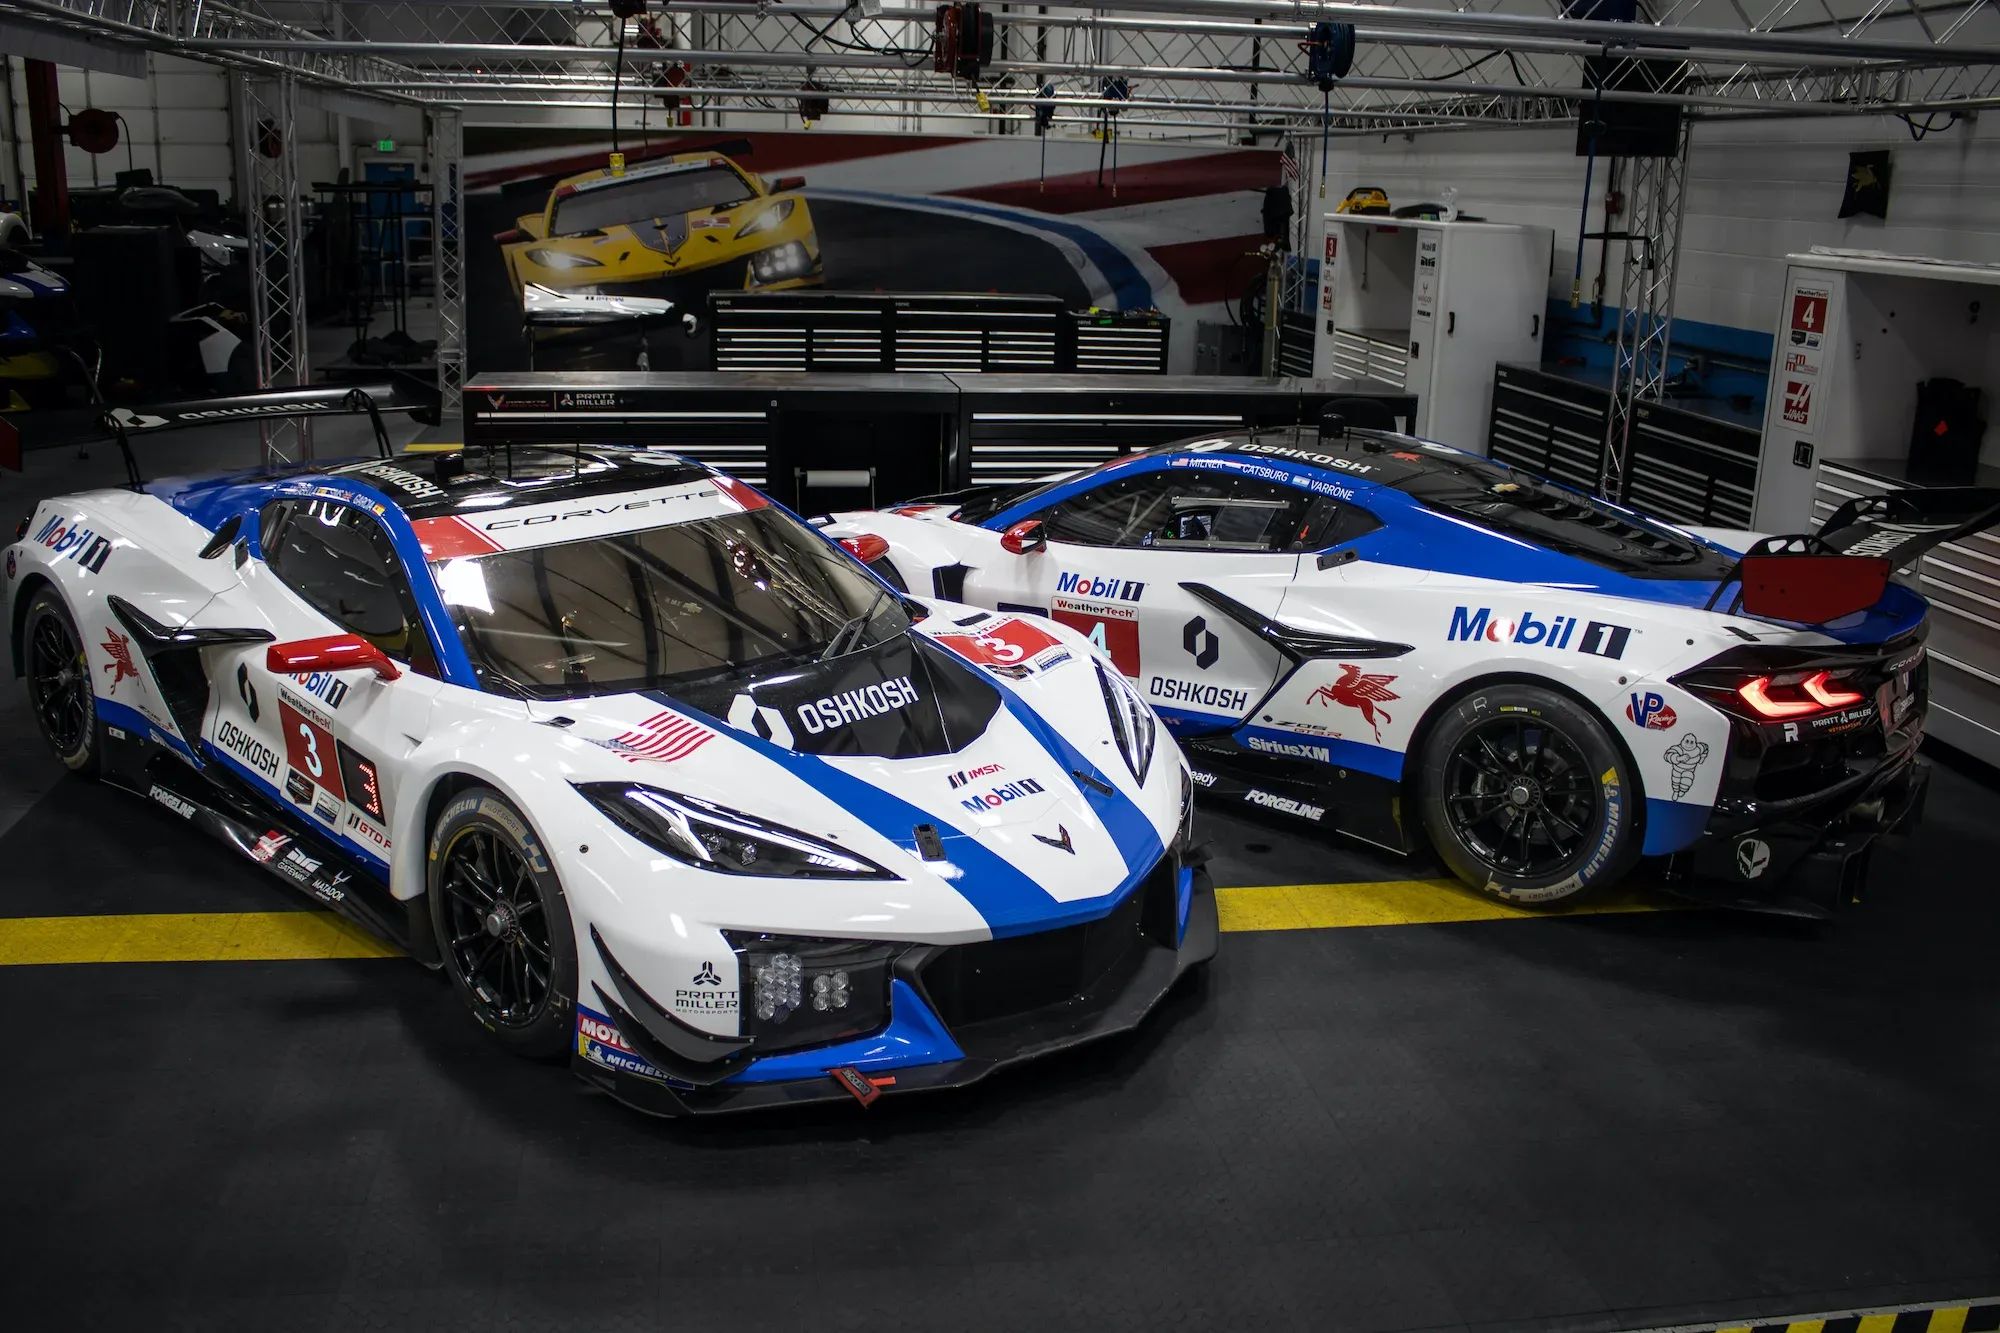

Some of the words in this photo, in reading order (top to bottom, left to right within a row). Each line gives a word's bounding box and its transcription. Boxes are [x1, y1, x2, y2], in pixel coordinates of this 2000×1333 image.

[1802, 301, 1815, 328] 4
[1238, 444, 1372, 473] OSHKOSH
[1189, 458, 1224, 469] MILNER
[1242, 464, 1289, 482] CATSBURG
[1310, 480, 1354, 501] VARRONE
[485, 489, 720, 531] CORVETTE
[33, 515, 94, 560] Mobil
[1057, 572, 1120, 599] Mobil
[1057, 600, 1134, 618] WeatherTech
[1086, 622, 1111, 658] 4
[1447, 606, 1577, 650] Mobil
[975, 637, 1024, 661] 3
[288, 672, 330, 698] obil
[1150, 677, 1248, 711] OSHKOSH
[280, 688, 331, 729] WeatherTech
[798, 677, 920, 735] OSHKOSH
[1631, 692, 1664, 728] VP
[1812, 716, 1839, 728] PRATT
[1849, 708, 1872, 720] MILLER
[218, 721, 280, 778] OSHKOSH
[300, 723, 323, 778] 3
[1248, 737, 1329, 763] SiriusXM
[968, 764, 1006, 779] IMSA
[149, 785, 196, 820] FORGELINE
[359, 763, 380, 814] 3
[960, 783, 1026, 814] Mobil
[1245, 790, 1325, 821] FORGELINE
[360, 821, 383, 844] GTD
[1583, 802, 1619, 878] MICHELIN
[277, 861, 308, 883] GATEWAY
[311, 879, 345, 902] MATADOR
[676, 990, 739, 999] PRATT
[676, 1000, 738, 1008] MILLER
